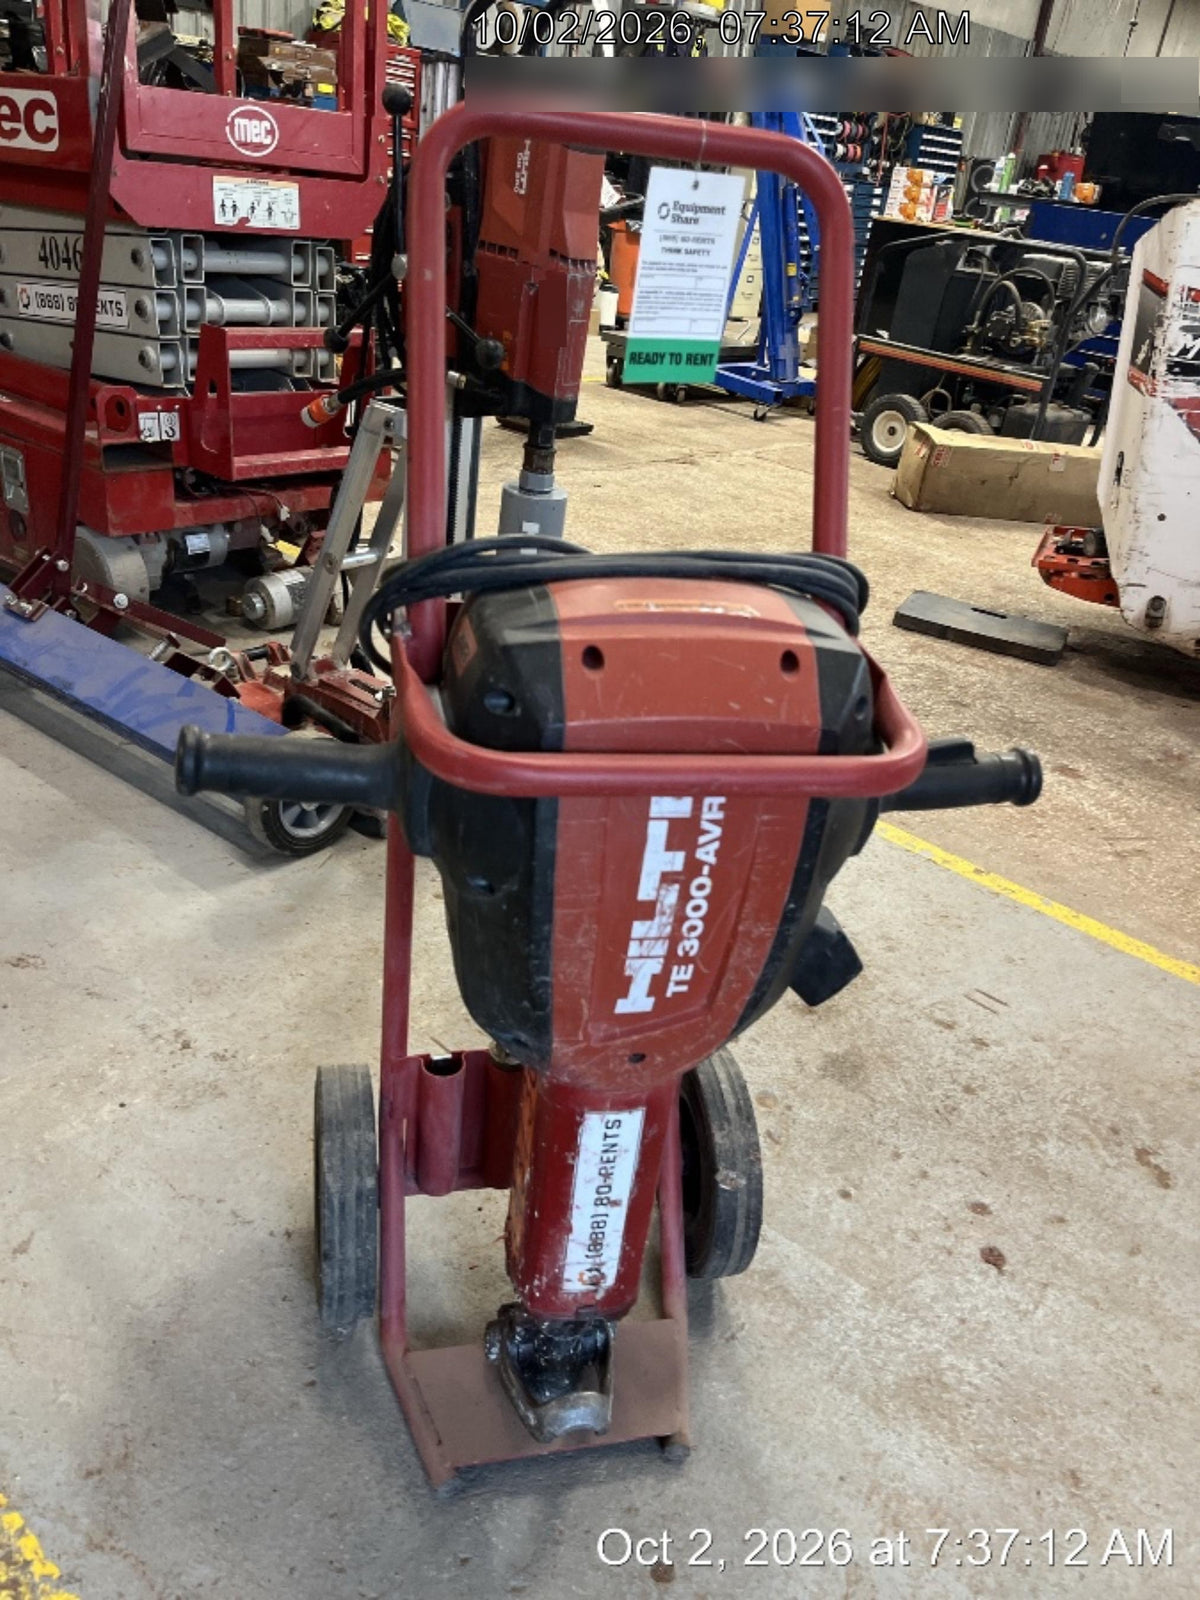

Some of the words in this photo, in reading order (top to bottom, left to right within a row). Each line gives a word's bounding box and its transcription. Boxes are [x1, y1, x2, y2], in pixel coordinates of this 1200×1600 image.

[671, 200, 726, 217] Equipment
[671, 213, 700, 225] Share
[628, 351, 666, 365] READY
[668, 352, 682, 365] TO
[685, 353, 715, 367] RENT
[677, 796, 727, 958] 3000-AVR
[614, 796, 694, 1014] HILTI
[666, 963, 695, 998] TE
[584, 1213, 610, 1260] (888)
